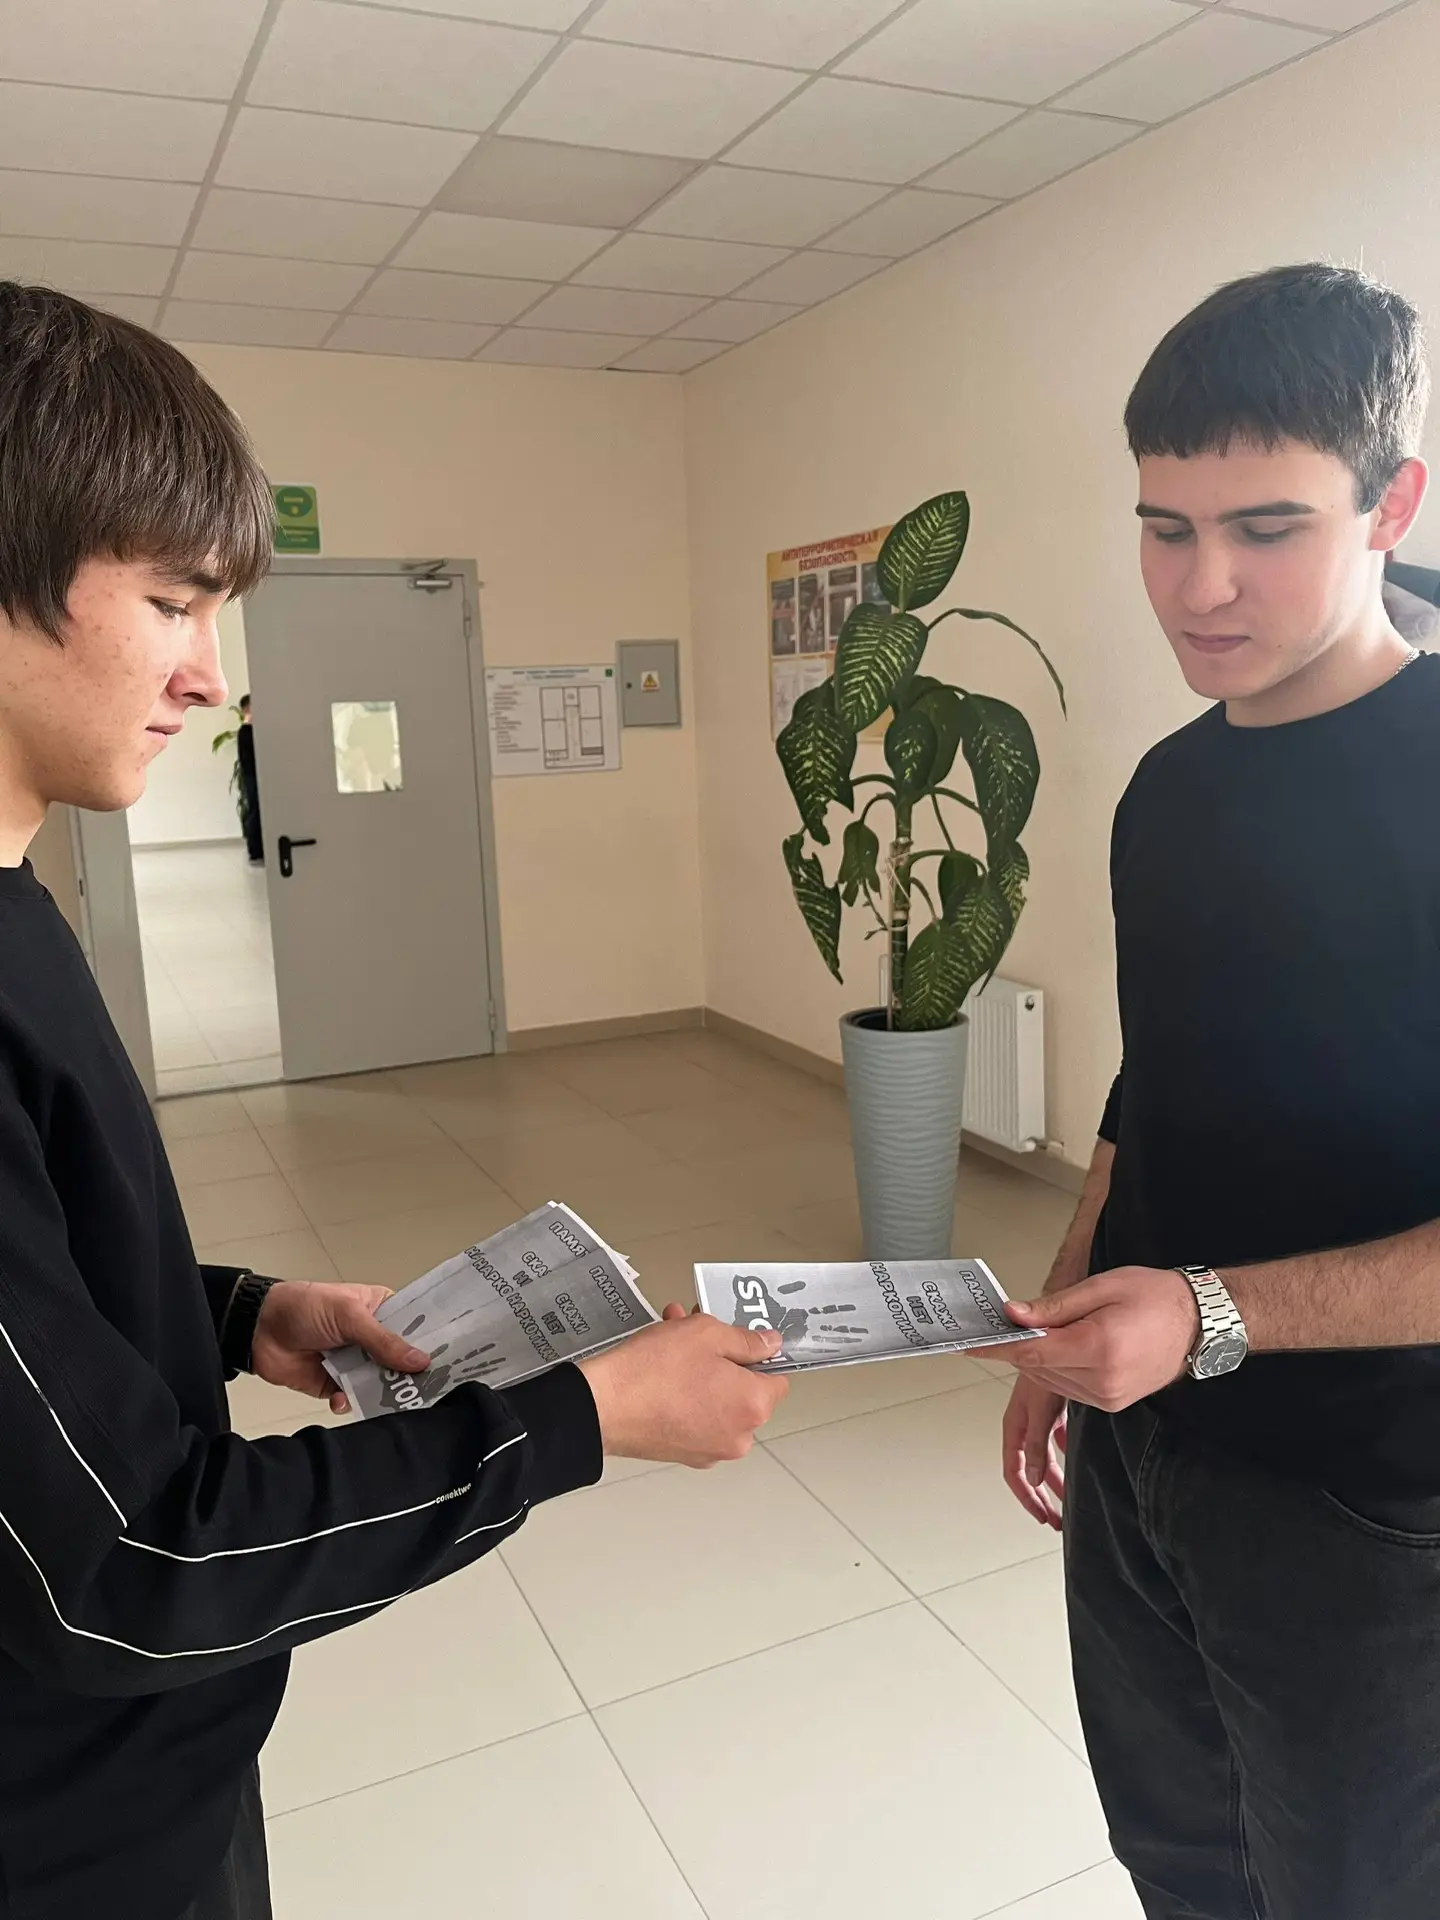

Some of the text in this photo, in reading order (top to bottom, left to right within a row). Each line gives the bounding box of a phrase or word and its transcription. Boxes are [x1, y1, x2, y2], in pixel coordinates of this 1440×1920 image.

[799, 549, 858, 570] БЕЗОПАСНОСТЬ
[521, 1250, 552, 1278] СКА
[589, 1265, 635, 1323] ПАМЯТКА
[906, 1295, 934, 1326] НЕТ
[922, 1281, 962, 1333] СКАЖИ
[959, 1270, 1010, 1331] ПАМЯТКА
[541, 1311, 566, 1336] НЕТ
[555, 1292, 591, 1335] СКАЖИ
